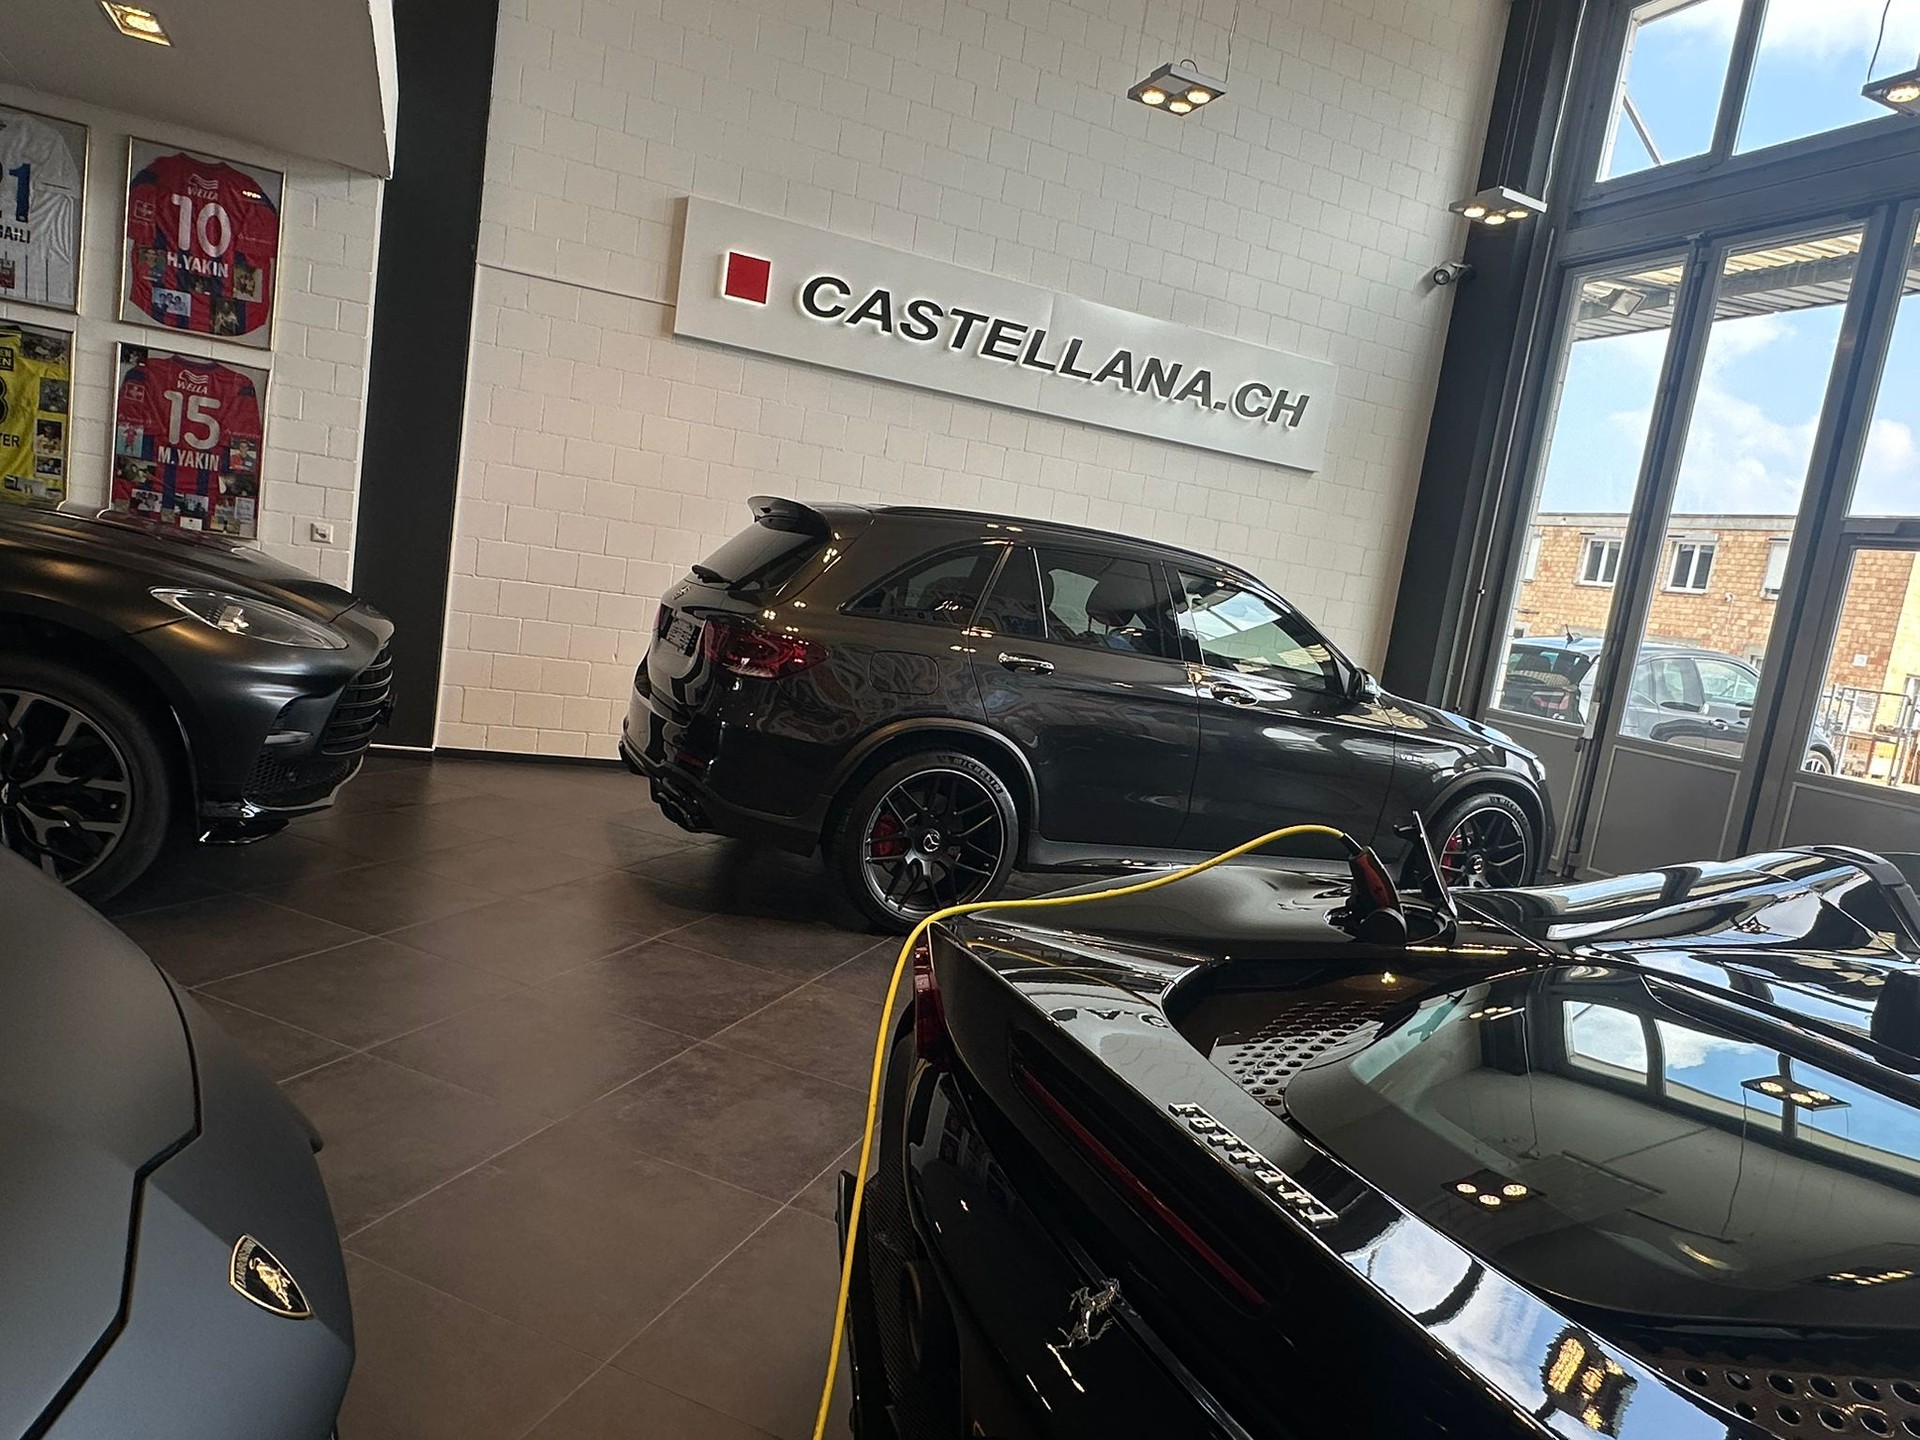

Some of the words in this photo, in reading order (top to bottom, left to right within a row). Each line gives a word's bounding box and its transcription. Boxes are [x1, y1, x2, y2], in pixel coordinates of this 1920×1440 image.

[0, 161, 31, 223] 1
[187, 186, 218, 200] WELLA
[171, 193, 231, 258] 10
[166, 251, 229, 278] H.YAKIN
[802, 276, 1310, 428] CASTELLANA.CH
[176, 380, 208, 395] WELLA
[163, 389, 221, 450] 15
[0, 432, 21, 449] ER
[157, 445, 219, 472] M.YAKIN
[953, 758, 1001, 792] MICHELIN
[1167, 1102, 1339, 1228] Ferrari
